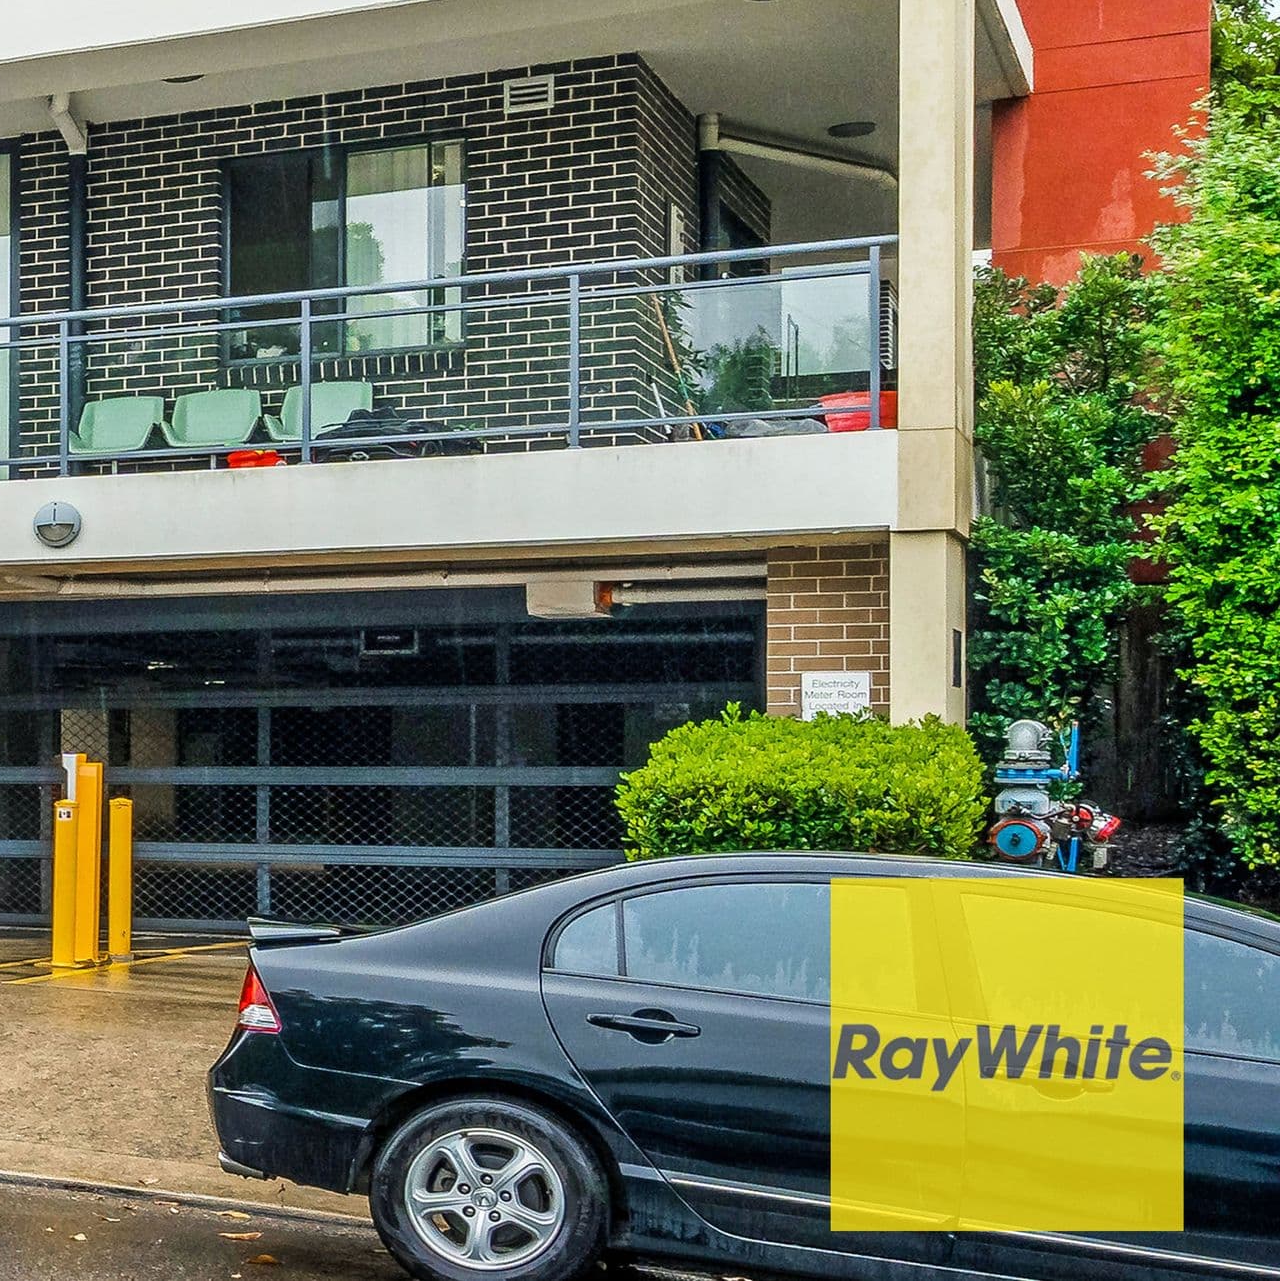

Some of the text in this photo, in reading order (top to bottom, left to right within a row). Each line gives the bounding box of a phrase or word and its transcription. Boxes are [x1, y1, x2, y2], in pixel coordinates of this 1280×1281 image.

[811, 679, 861, 690] Electricity
[804, 690, 867, 700] Meter Room
